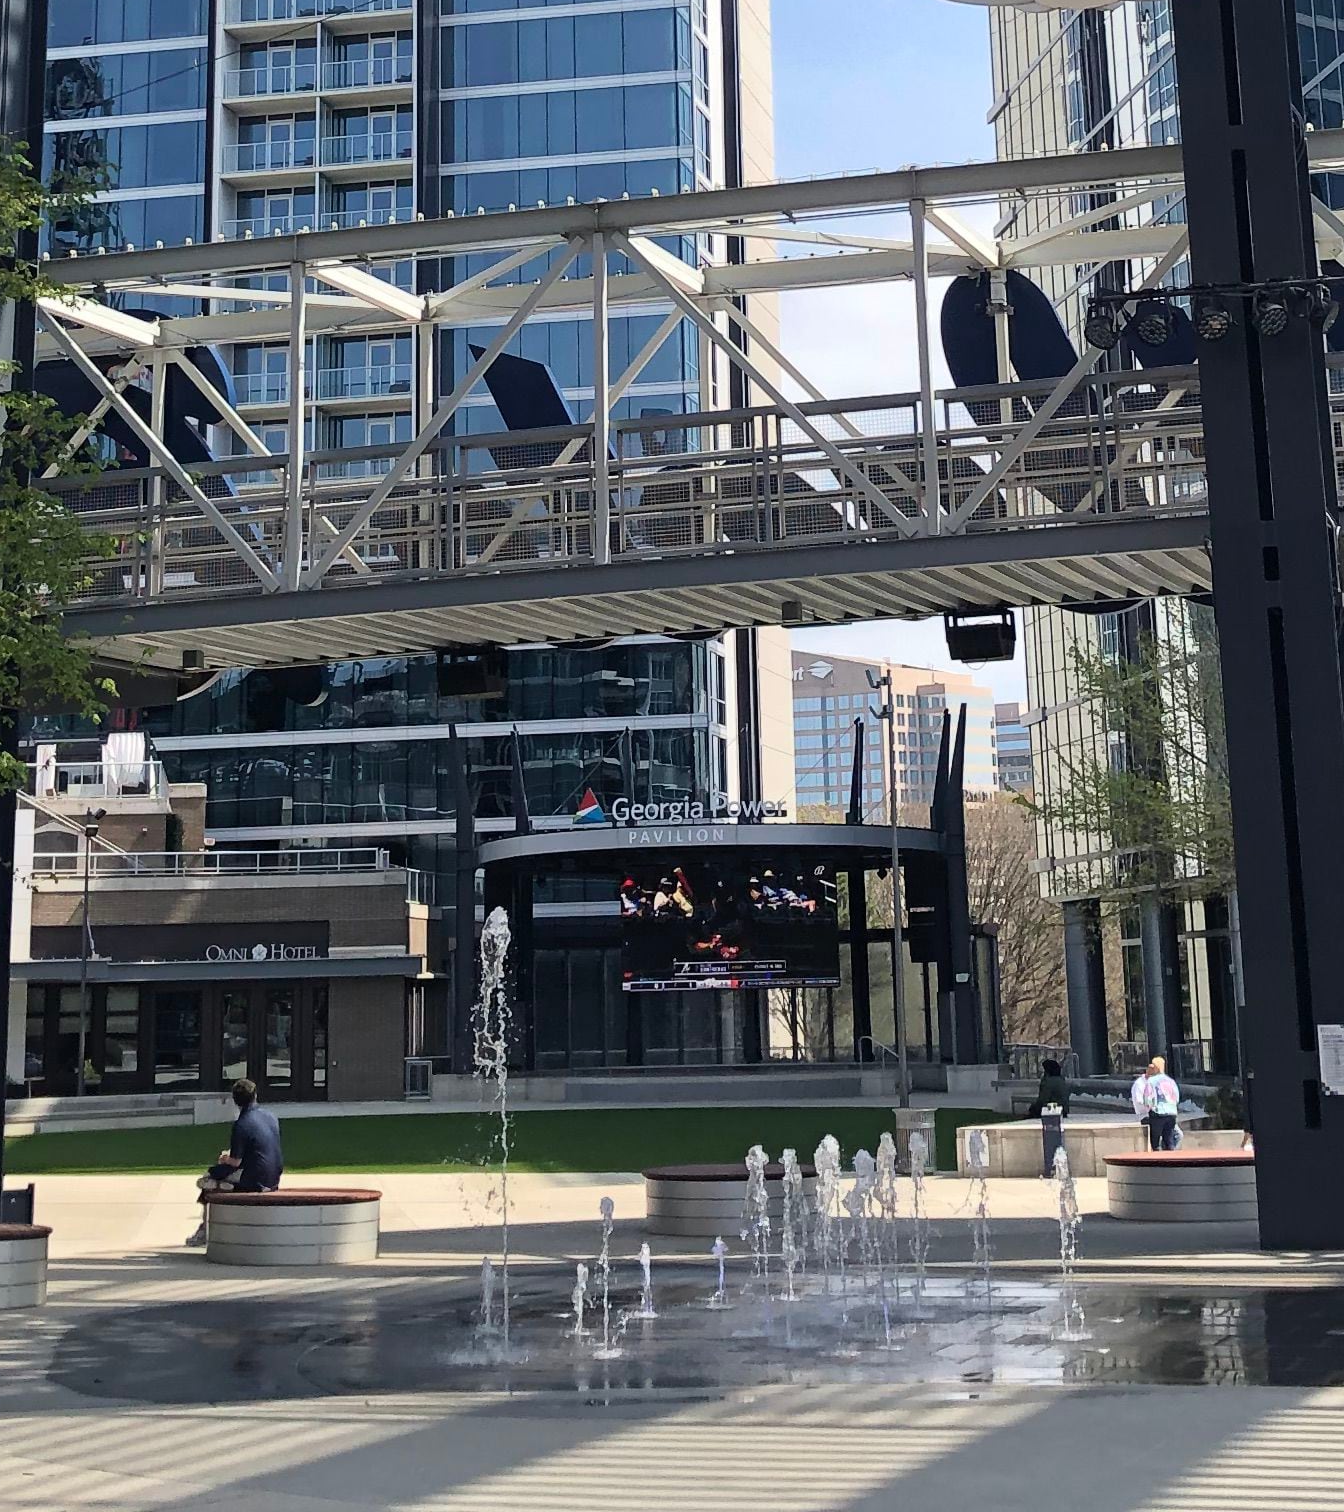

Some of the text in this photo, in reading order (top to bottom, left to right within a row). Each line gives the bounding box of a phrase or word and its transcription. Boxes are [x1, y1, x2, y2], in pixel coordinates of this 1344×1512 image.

[611, 794, 787, 823] Georgia Power
[628, 829, 724, 844] PAVILION
[205, 943, 321, 961] OMNI HOTEL
